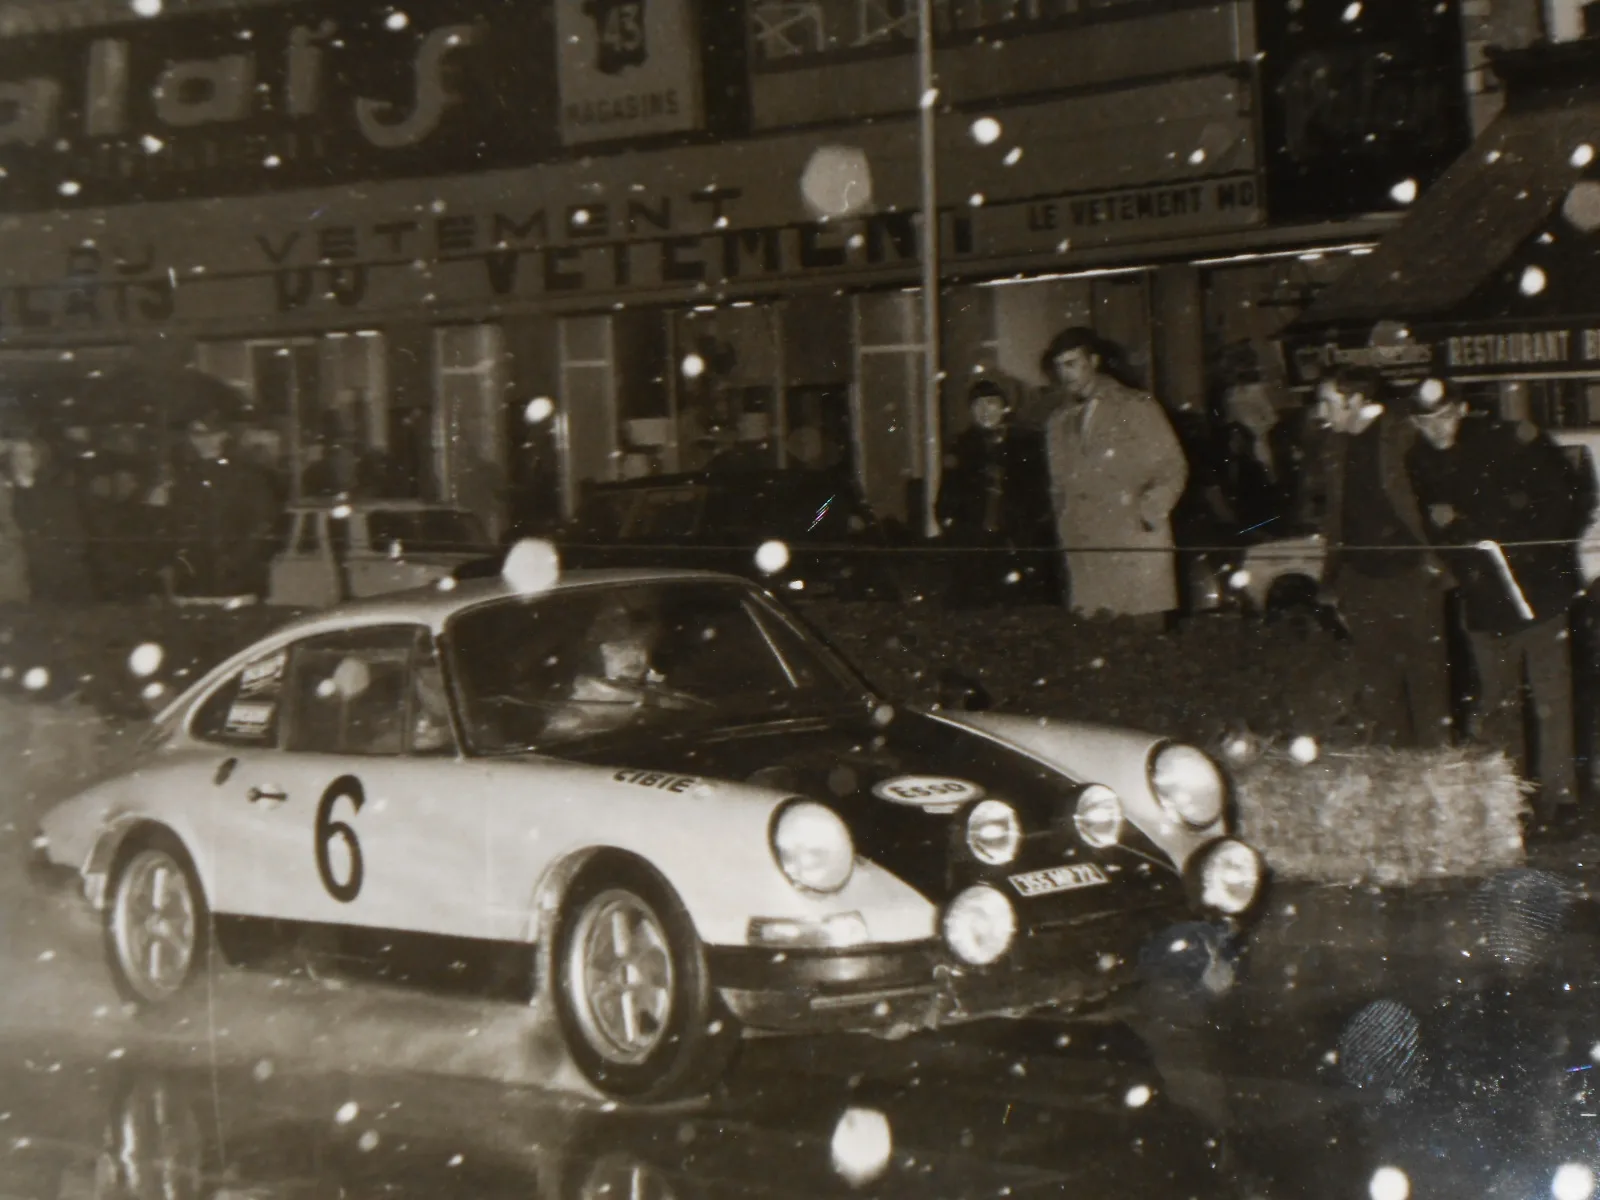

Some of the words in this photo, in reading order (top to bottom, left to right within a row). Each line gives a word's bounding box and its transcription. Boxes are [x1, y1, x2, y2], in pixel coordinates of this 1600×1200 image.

[603, 3, 640, 51] 43
[563, 88, 680, 124] MAGASINS
[254, 186, 743, 264] VETEMENT
[1026, 203, 1059, 232] LE
[1069, 185, 1203, 227] VETEMENT
[1448, 330, 1569, 366] RESTAURANT
[1582, 328, 1600, 360] B
[612, 768, 696, 793] CIBIE
[315, 774, 367, 904] 6
